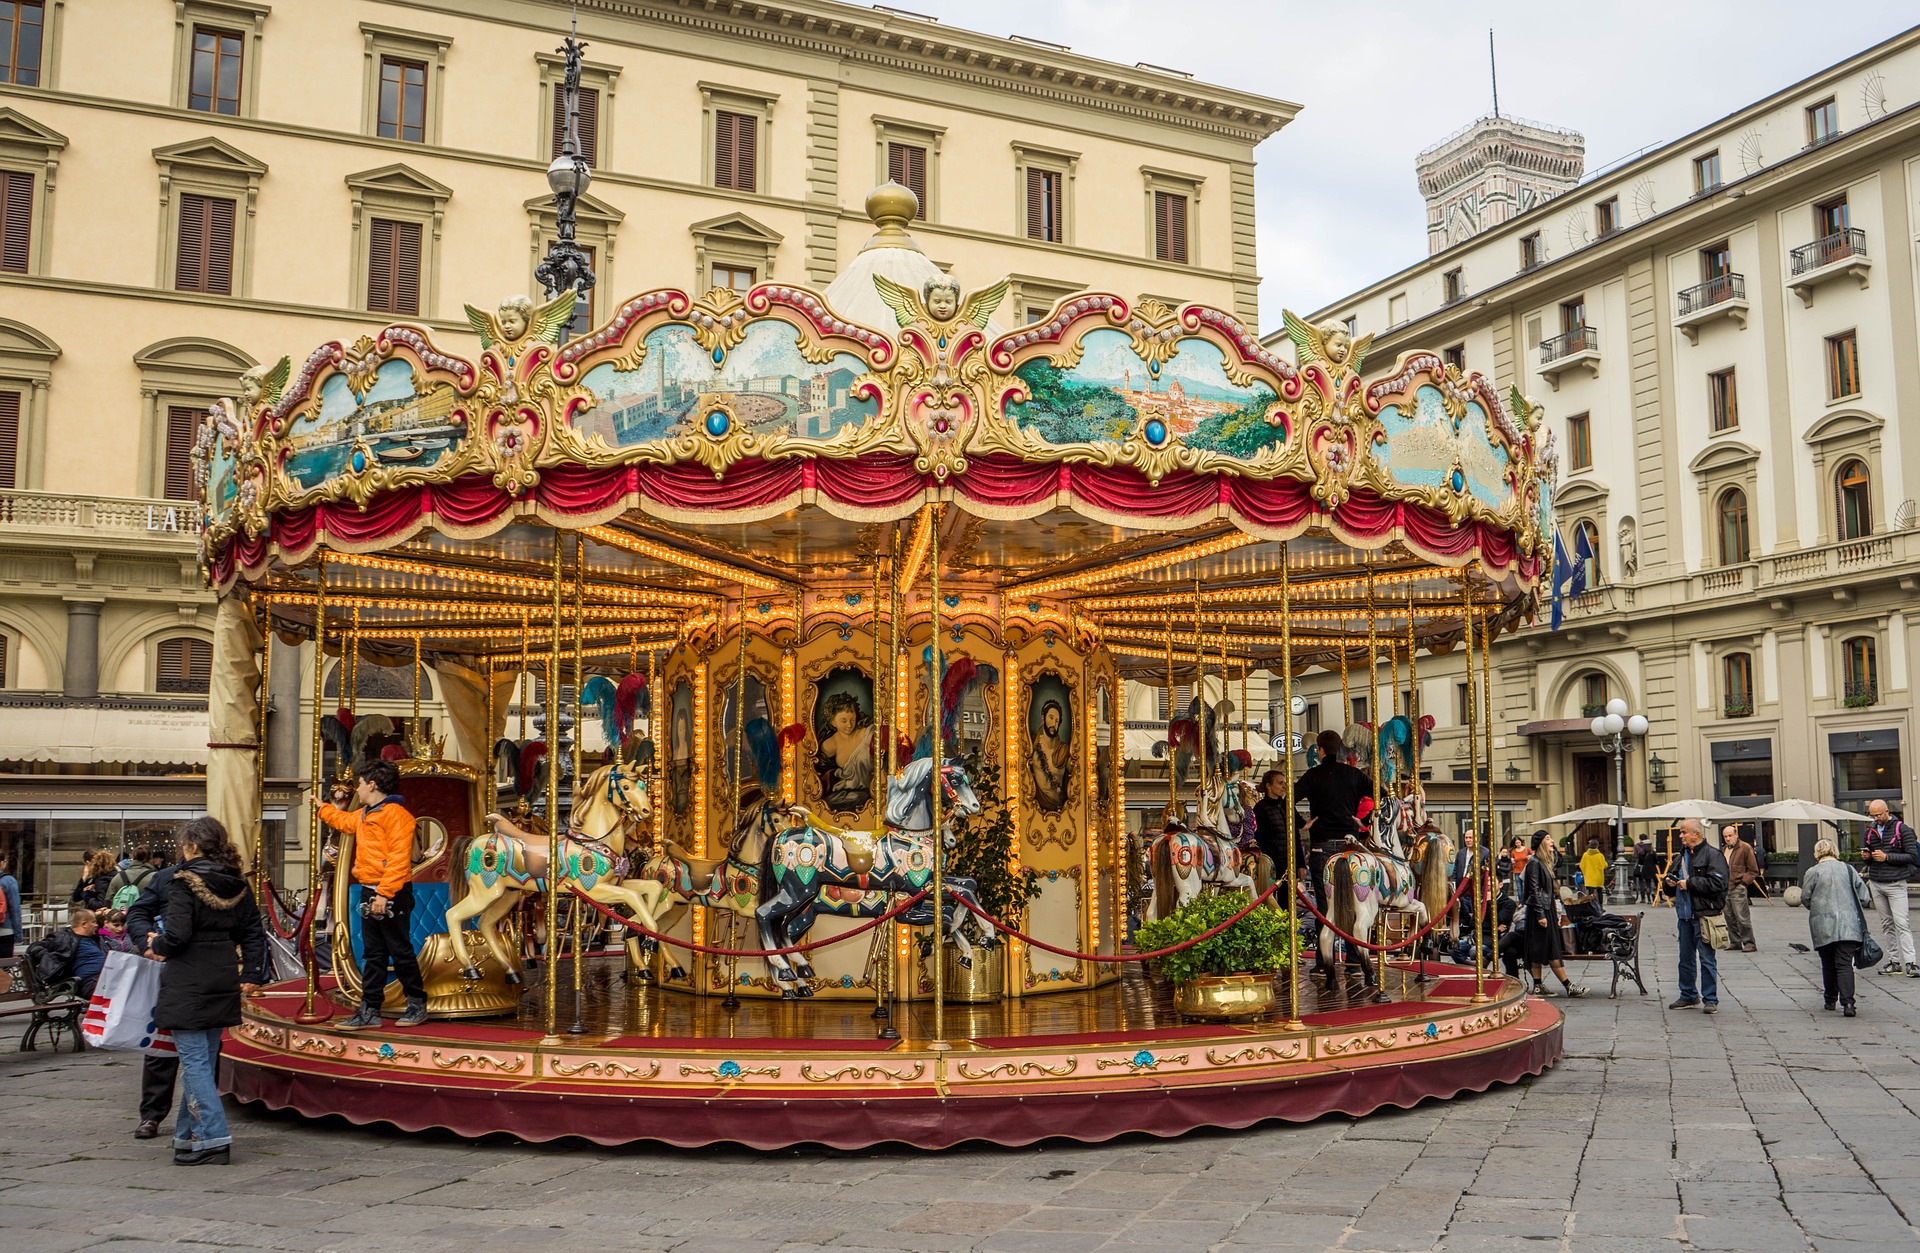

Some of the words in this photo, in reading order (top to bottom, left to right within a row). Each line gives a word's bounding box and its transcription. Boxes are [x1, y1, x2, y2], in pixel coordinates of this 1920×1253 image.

[147, 505, 178, 532] LA
[127, 719, 209, 727] PASZKOWSK
[1275, 738, 1301, 748] GiLi
